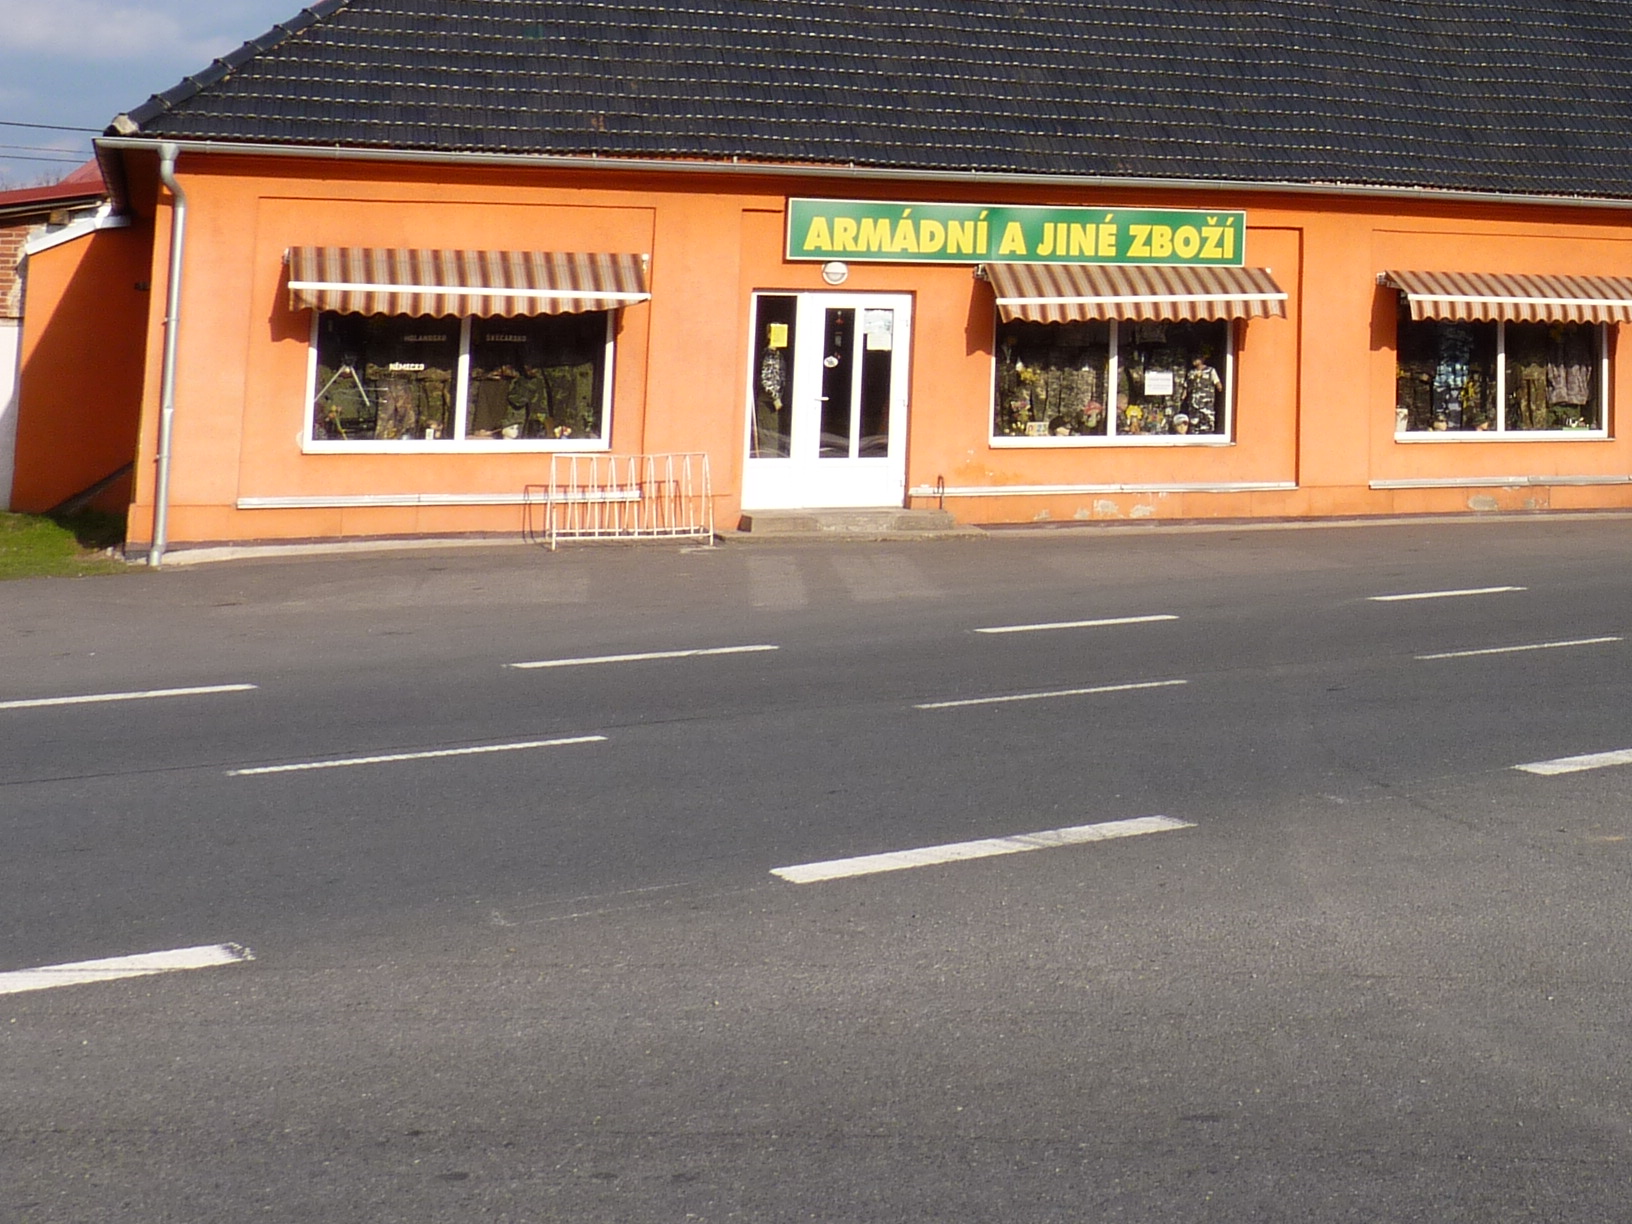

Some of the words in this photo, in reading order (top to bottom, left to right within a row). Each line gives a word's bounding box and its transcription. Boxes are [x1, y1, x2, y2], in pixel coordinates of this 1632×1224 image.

[804, 209, 989, 255] ARMÁDNÍ
[999, 220, 1027, 256] A
[1036, 215, 1117, 257] JINÉ
[1127, 217, 1234, 259] ZBOŽÍ
